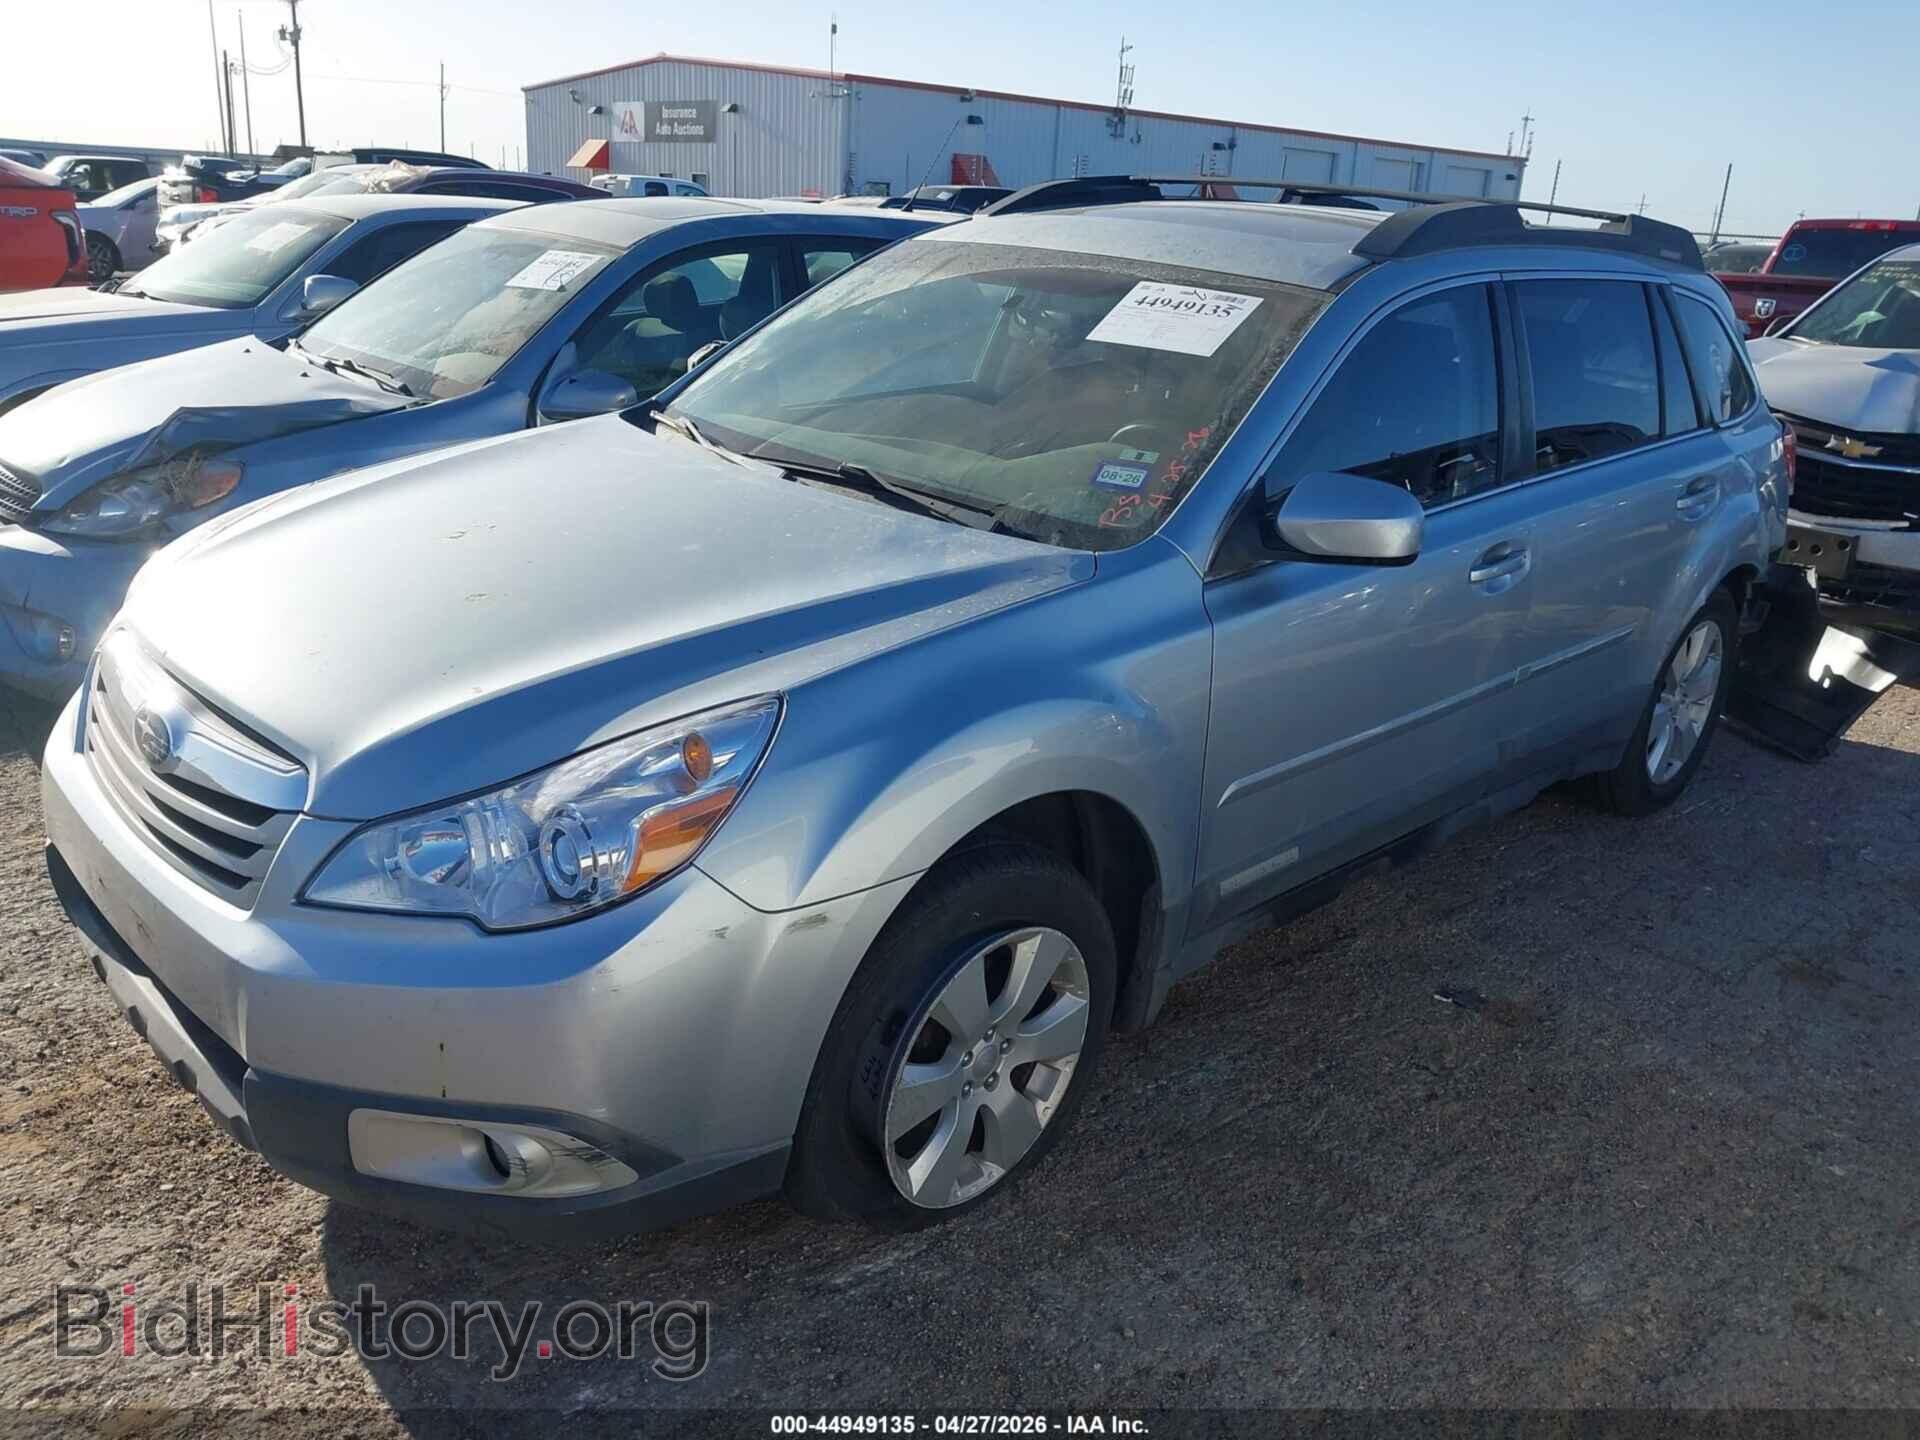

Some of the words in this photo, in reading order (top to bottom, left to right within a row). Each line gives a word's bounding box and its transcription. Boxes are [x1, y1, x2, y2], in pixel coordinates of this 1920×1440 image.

[662, 105, 697, 119] Insurance
[656, 121, 672, 136] Auto
[673, 121, 704, 136] Auctions
[1134, 294, 1233, 318] 44949135
